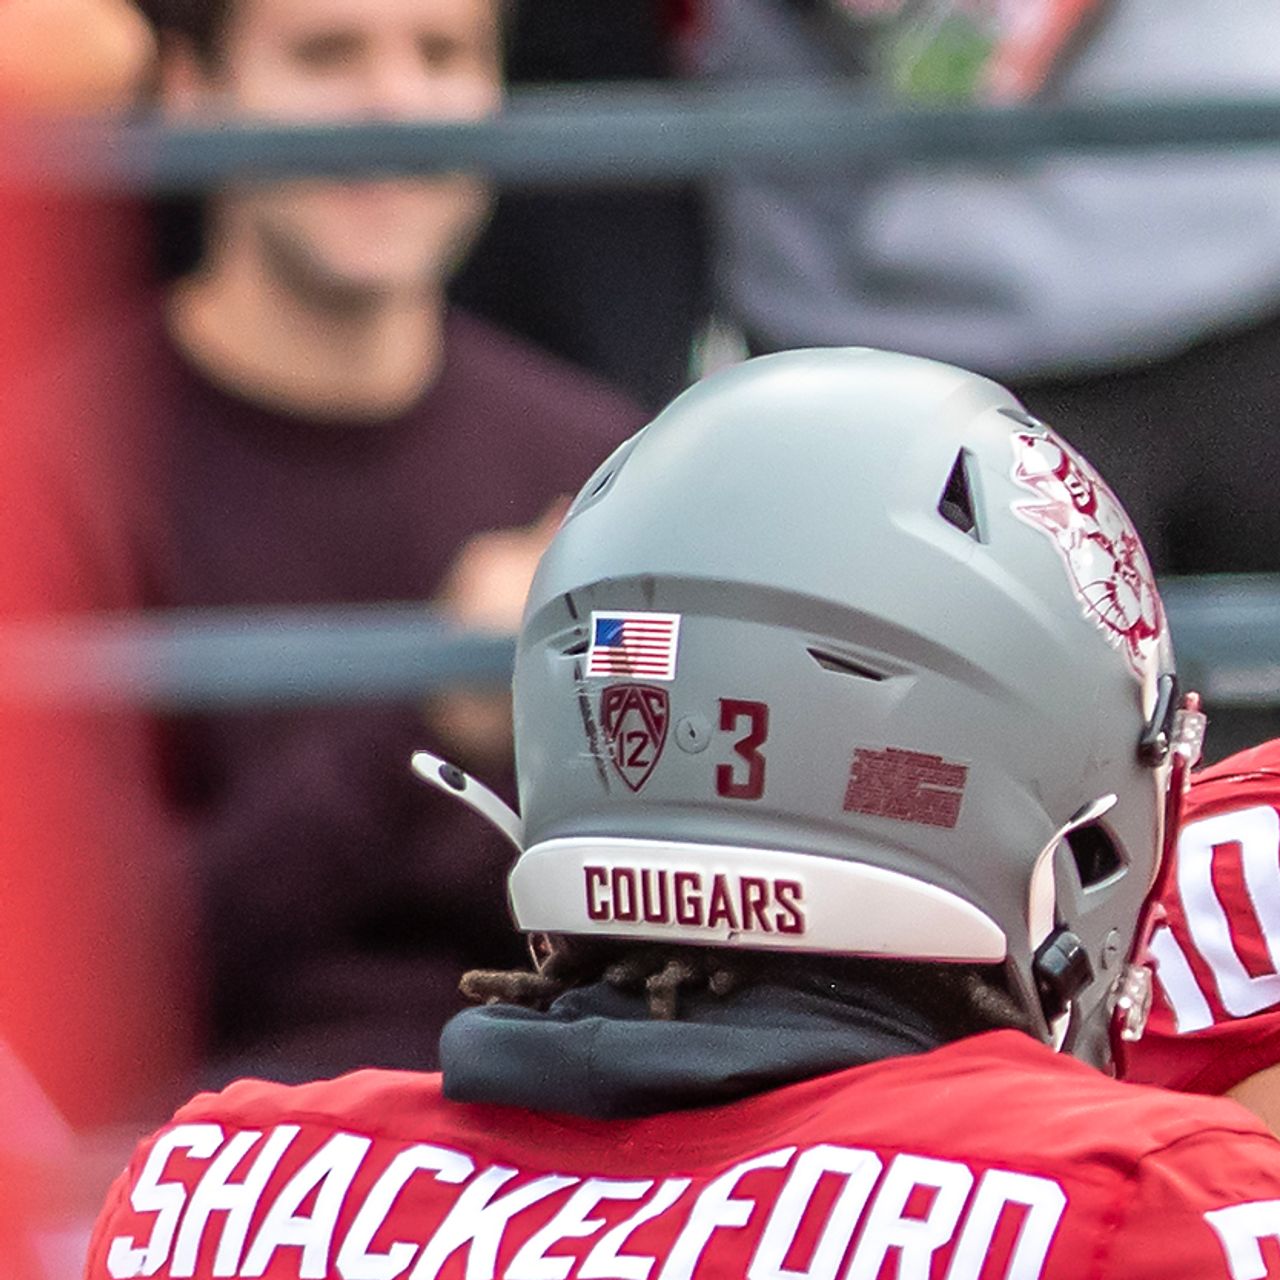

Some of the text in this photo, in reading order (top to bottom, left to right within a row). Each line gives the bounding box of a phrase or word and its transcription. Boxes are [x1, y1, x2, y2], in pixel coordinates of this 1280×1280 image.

[617, 730, 651, 768] 12
[715, 697, 769, 801] 3
[583, 865, 806, 935] COUGARS
